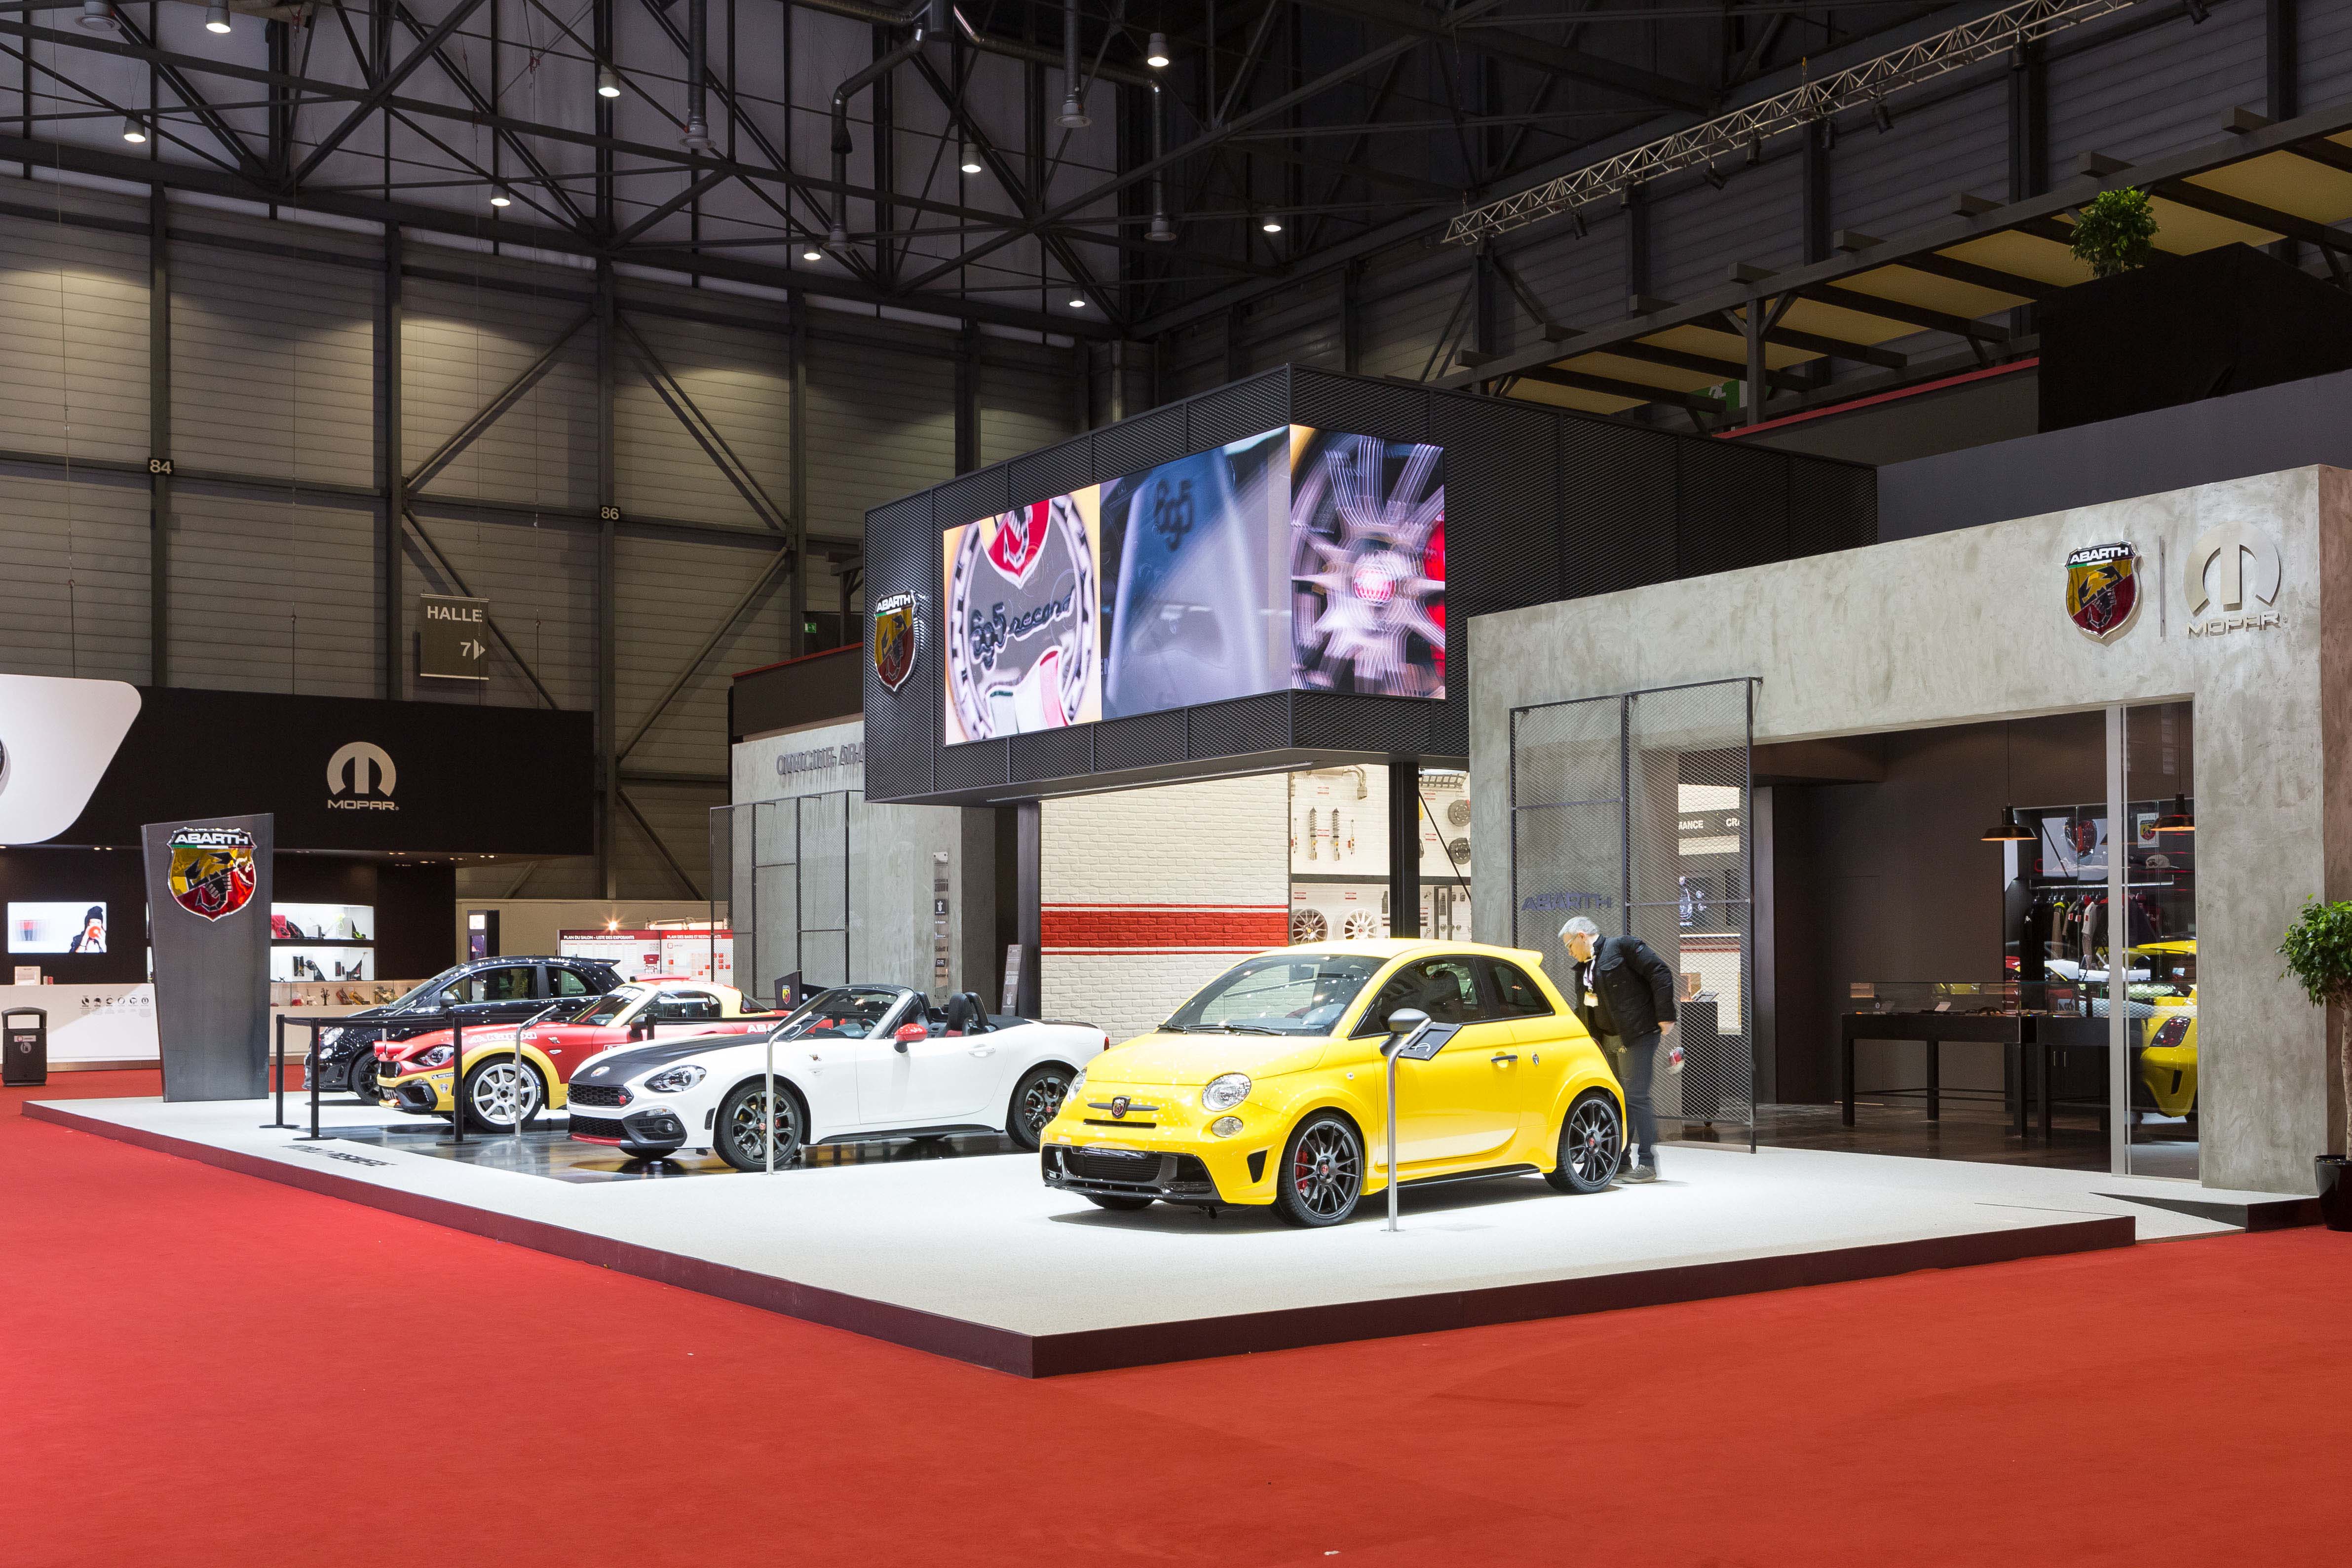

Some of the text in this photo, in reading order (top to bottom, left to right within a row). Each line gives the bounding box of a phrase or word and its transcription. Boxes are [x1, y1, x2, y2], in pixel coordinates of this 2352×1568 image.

[150, 459, 172, 474] 84
[601, 507, 619, 520] 86
[2070, 547, 2128, 564] ABARTH
[876, 595, 910, 612] ABARTH
[427, 606, 483, 622] HALLE
[460, 642, 471, 656] 7
[175, 833, 248, 844] ABARTH
[1521, 892, 1612, 911] ABARTH
